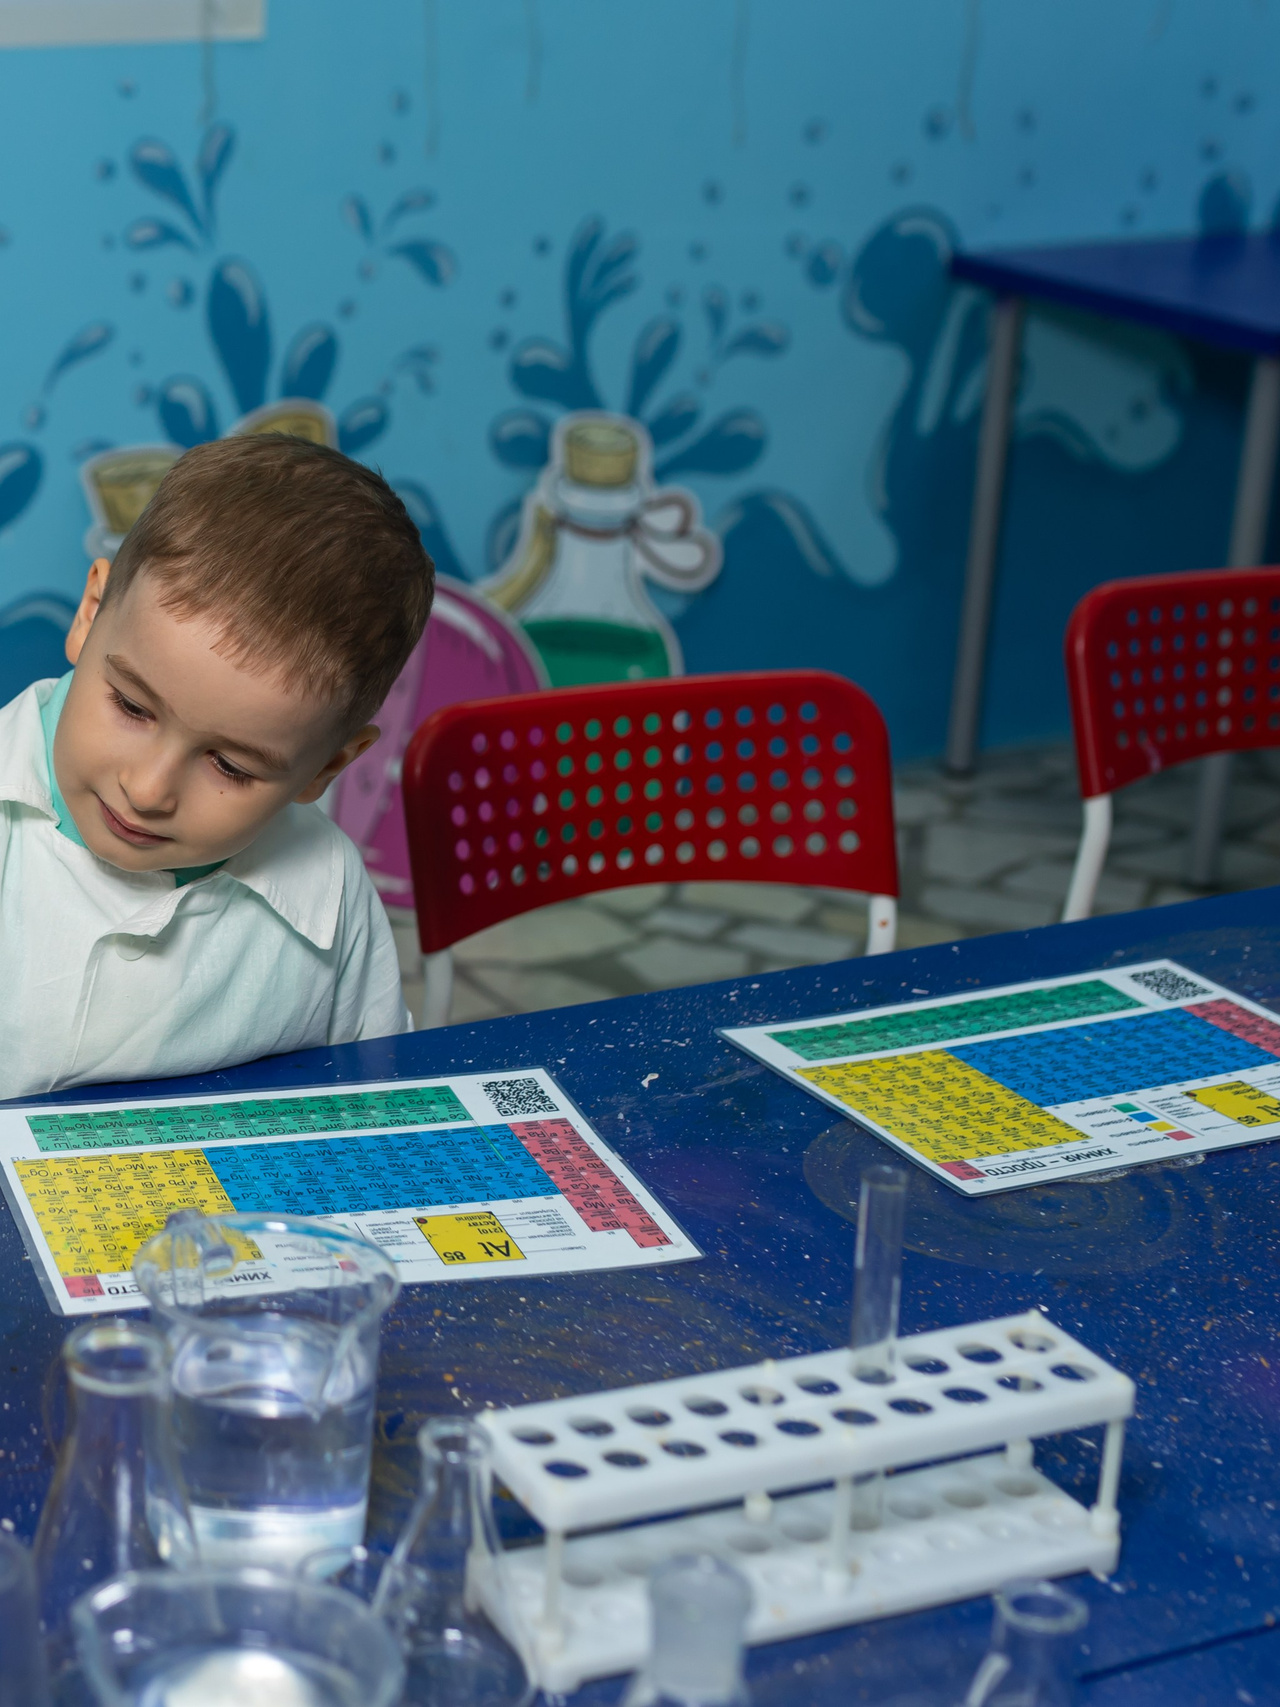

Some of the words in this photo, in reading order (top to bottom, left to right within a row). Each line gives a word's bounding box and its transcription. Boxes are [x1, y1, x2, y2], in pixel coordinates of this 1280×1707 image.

[347, 1102, 365, 1110] Np
[384, 1100, 395, 1108] U
[407, 1098, 425, 1106] Pa
[228, 1111, 245, 1119] Bk
[423, 1115, 437, 1123] Pr
[104, 1120, 123, 1128] Md
[134, 1118, 154, 1126] Fm
[167, 1116, 184, 1124] Es
[355, 1120, 377, 1128] Pm
[388, 1118, 407, 1126] Nd
[298, 1124, 316, 1132] Eu
[325, 1122, 346, 1130] Sm
[207, 1130, 225, 1139] Dy
[238, 1129, 256, 1137] Tb
[266, 1127, 286, 1135] Gd
[563, 1128, 576, 1136] Fr
[149, 1135, 163, 1143] Er
[175, 1133, 194, 1141] Ho
[82, 1140, 101, 1148] Yb
[112, 1138, 132, 1146] Tm
[405, 1141, 424, 1149] Sg
[436, 1139, 455, 1147] Db
[541, 1147, 560, 1155] Ba
[250, 1153, 270, 1161] Rg
[450, 1156, 469, 1164] Ta
[189, 1158, 208, 1166] Nh
[423, 1159, 438, 1167] W
[586, 1161, 606, 1169] Rb
[65, 1167, 81, 1175] Ts
[124, 1163, 144, 1171] Mc
[560, 1164, 575, 1172] Sr
[29, 1168, 49, 1177] Og
[297, 1168, 313, 1176] Pt
[498, 1171, 513, 1179] Zr
[229, 1173, 249, 1181] Hg
[429, 1176, 450, 1184] Mo
[462, 1174, 482, 1182] Nb
[168, 1178, 186, 1186] Pb
[368, 1181, 388, 1189] Ru
[402, 1179, 420, 1187] Tc
[569, 1182, 589, 1190] Ca
[608, 1178, 621, 1186] K
[75, 1185, 88, 1193] At
[104, 1183, 122, 1191] Po
[306, 1186, 324, 1194] Pd
[336, 1184, 356, 1192] Rh
[539, 1186, 558, 1194] Sc
[240, 1191, 260, 1200] Cd
[273, 1188, 290, 1197] Ag
[486, 1192, 496, 1200] V
[410, 1197, 432, 1205] Mn
[448, 1194, 463, 1202] Cr
[616, 1197, 637, 1205] Na
[145, 1199, 163, 1207] Sb
[348, 1202, 368, 1210] Co
[582, 1200, 605, 1209] Mg
[48, 1206, 65, 1214] Xe
[321, 1205, 336, 1213] Ni
[93, 1223, 108, 1231] Br
[122, 1220, 141, 1228] Se
[600, 1219, 621, 1229] Be
[60, 1225, 75, 1234] Kr
[656, 1235, 669, 1245] H
[69, 1245, 82, 1254] Ar
[102, 1243, 117, 1251] Cl
[477, 1240, 510, 1257] At
[442, 1250, 466, 1261] 85
